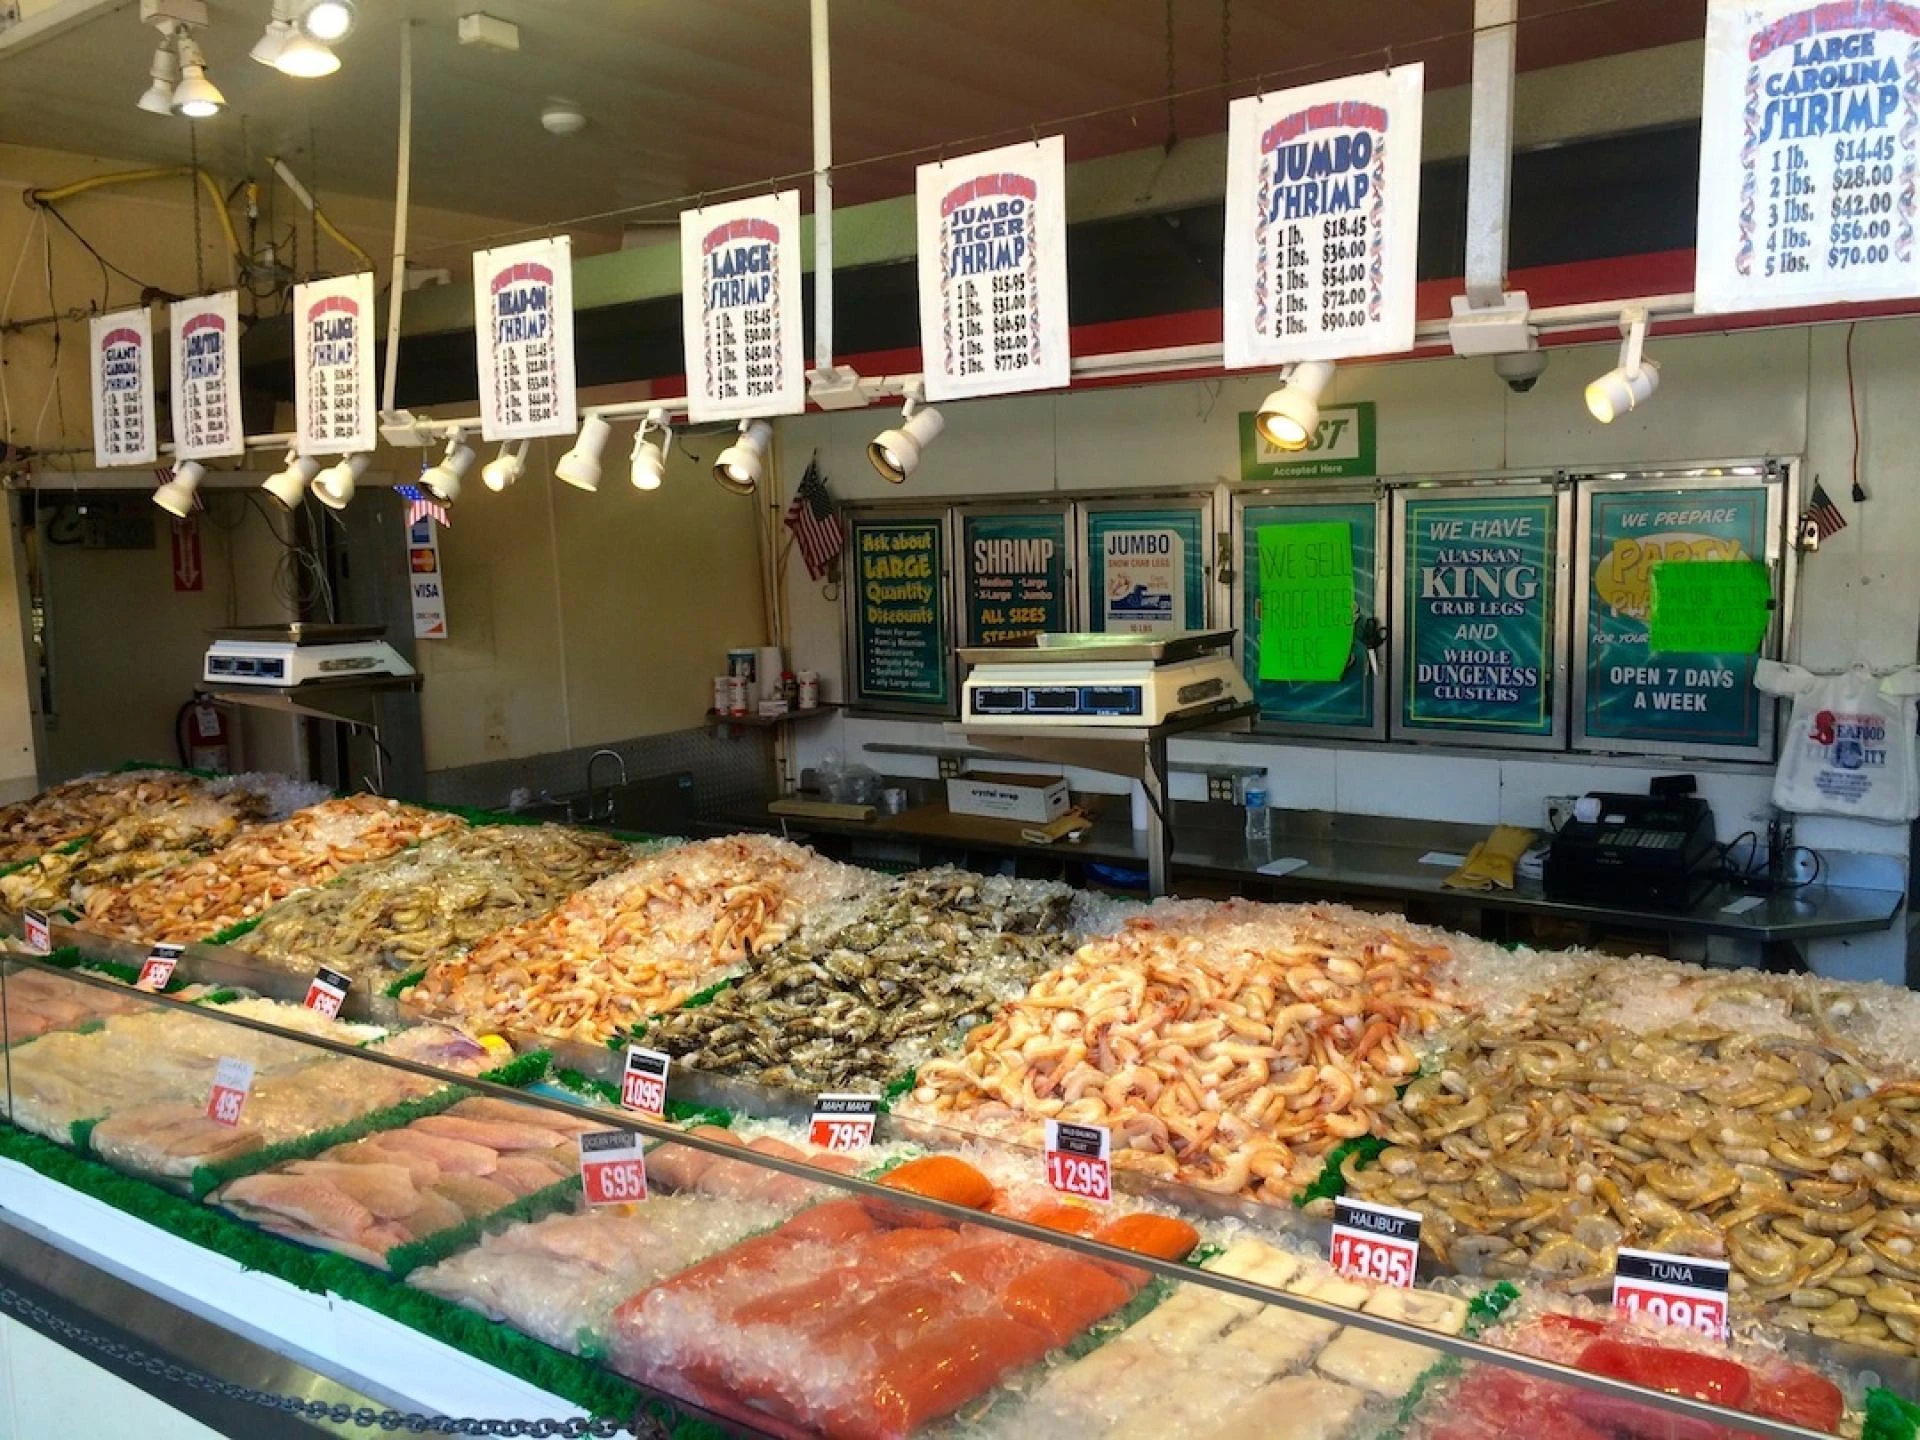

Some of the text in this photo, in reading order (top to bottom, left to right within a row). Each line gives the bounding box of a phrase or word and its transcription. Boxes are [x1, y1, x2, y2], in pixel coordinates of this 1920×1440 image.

[1794, 32, 1875, 66] LARGE
[1766, 57, 1900, 96] CAROLINA
[1759, 84, 1899, 144] SHRIMP
[1273, 132, 1372, 185] JUMBO
[1772, 136, 1895, 171] 1 lb. $14.45
[1770, 164, 1893, 198] 2 lbs. $28.00
[1269, 174, 1368, 222] SHRIMP
[1769, 192, 1891, 228] 3 lbs. $42.00
[951, 199, 1024, 226] JUMBO
[951, 219, 1024, 244] TIGER
[1277, 217, 1366, 247] 1 lb. $18.45
[1767, 220, 1890, 251] 4 lbs. $56.00
[711, 244, 771, 279] LARGE
[951, 237, 1025, 277] SHRIMP
[1276, 241, 1366, 269] 2 lbs. $36.00
[1765, 245, 1888, 276] 5 lbs. $70.00
[710, 275, 770, 310] SHRIMP
[1276, 265, 1365, 294] 3 lbs. $54.00
[499, 286, 546, 316] HEAD-ON
[1276, 288, 1365, 315] 4 lbs. $72.00
[499, 313, 546, 343] SHRIMP
[1276, 311, 1365, 338] 5 lbs. $90.00
[1272, 464, 1342, 476] Accepted Here
[1430, 518, 1531, 540] WE HAVE
[1622, 508, 1738, 528] WE PREPARE
[863, 530, 931, 552] Ask about
[1108, 534, 1169, 555] JUMBO
[864, 556, 931, 579] LARGE
[974, 538, 1054, 574] SHRIMP
[1260, 542, 1351, 579] WE SELL
[1436, 548, 1521, 564] ALASKAN
[415, 583, 440, 598] VISA
[866, 580, 932, 604] Quantity
[1420, 565, 1538, 600] KING
[867, 606, 933, 625] Discounts
[981, 607, 1046, 624] ALL SIZES
[1430, 600, 1524, 616] CRAB LEGS
[1454, 623, 1498, 640] AND
[1594, 634, 1614, 643] FOR
[1444, 648, 1510, 664] WHOLE
[1418, 664, 1538, 687] DUNGENESS
[1610, 668, 1734, 689] OPEN 7 DAYS
[1434, 686, 1518, 702] CLUSTERS
[1634, 692, 1708, 712] A WEEK
[624, 1074, 663, 1112] 1095
[822, 1101, 872, 1111] MAHI MAHI
[828, 1125, 868, 1150] 795
[600, 1163, 640, 1198] 695
[1053, 1156, 1106, 1198] 1295
[1350, 1211, 1405, 1234] HALIBUT
[1339, 1239, 1408, 1286] 1395
[1650, 1263, 1693, 1282] TUNA
